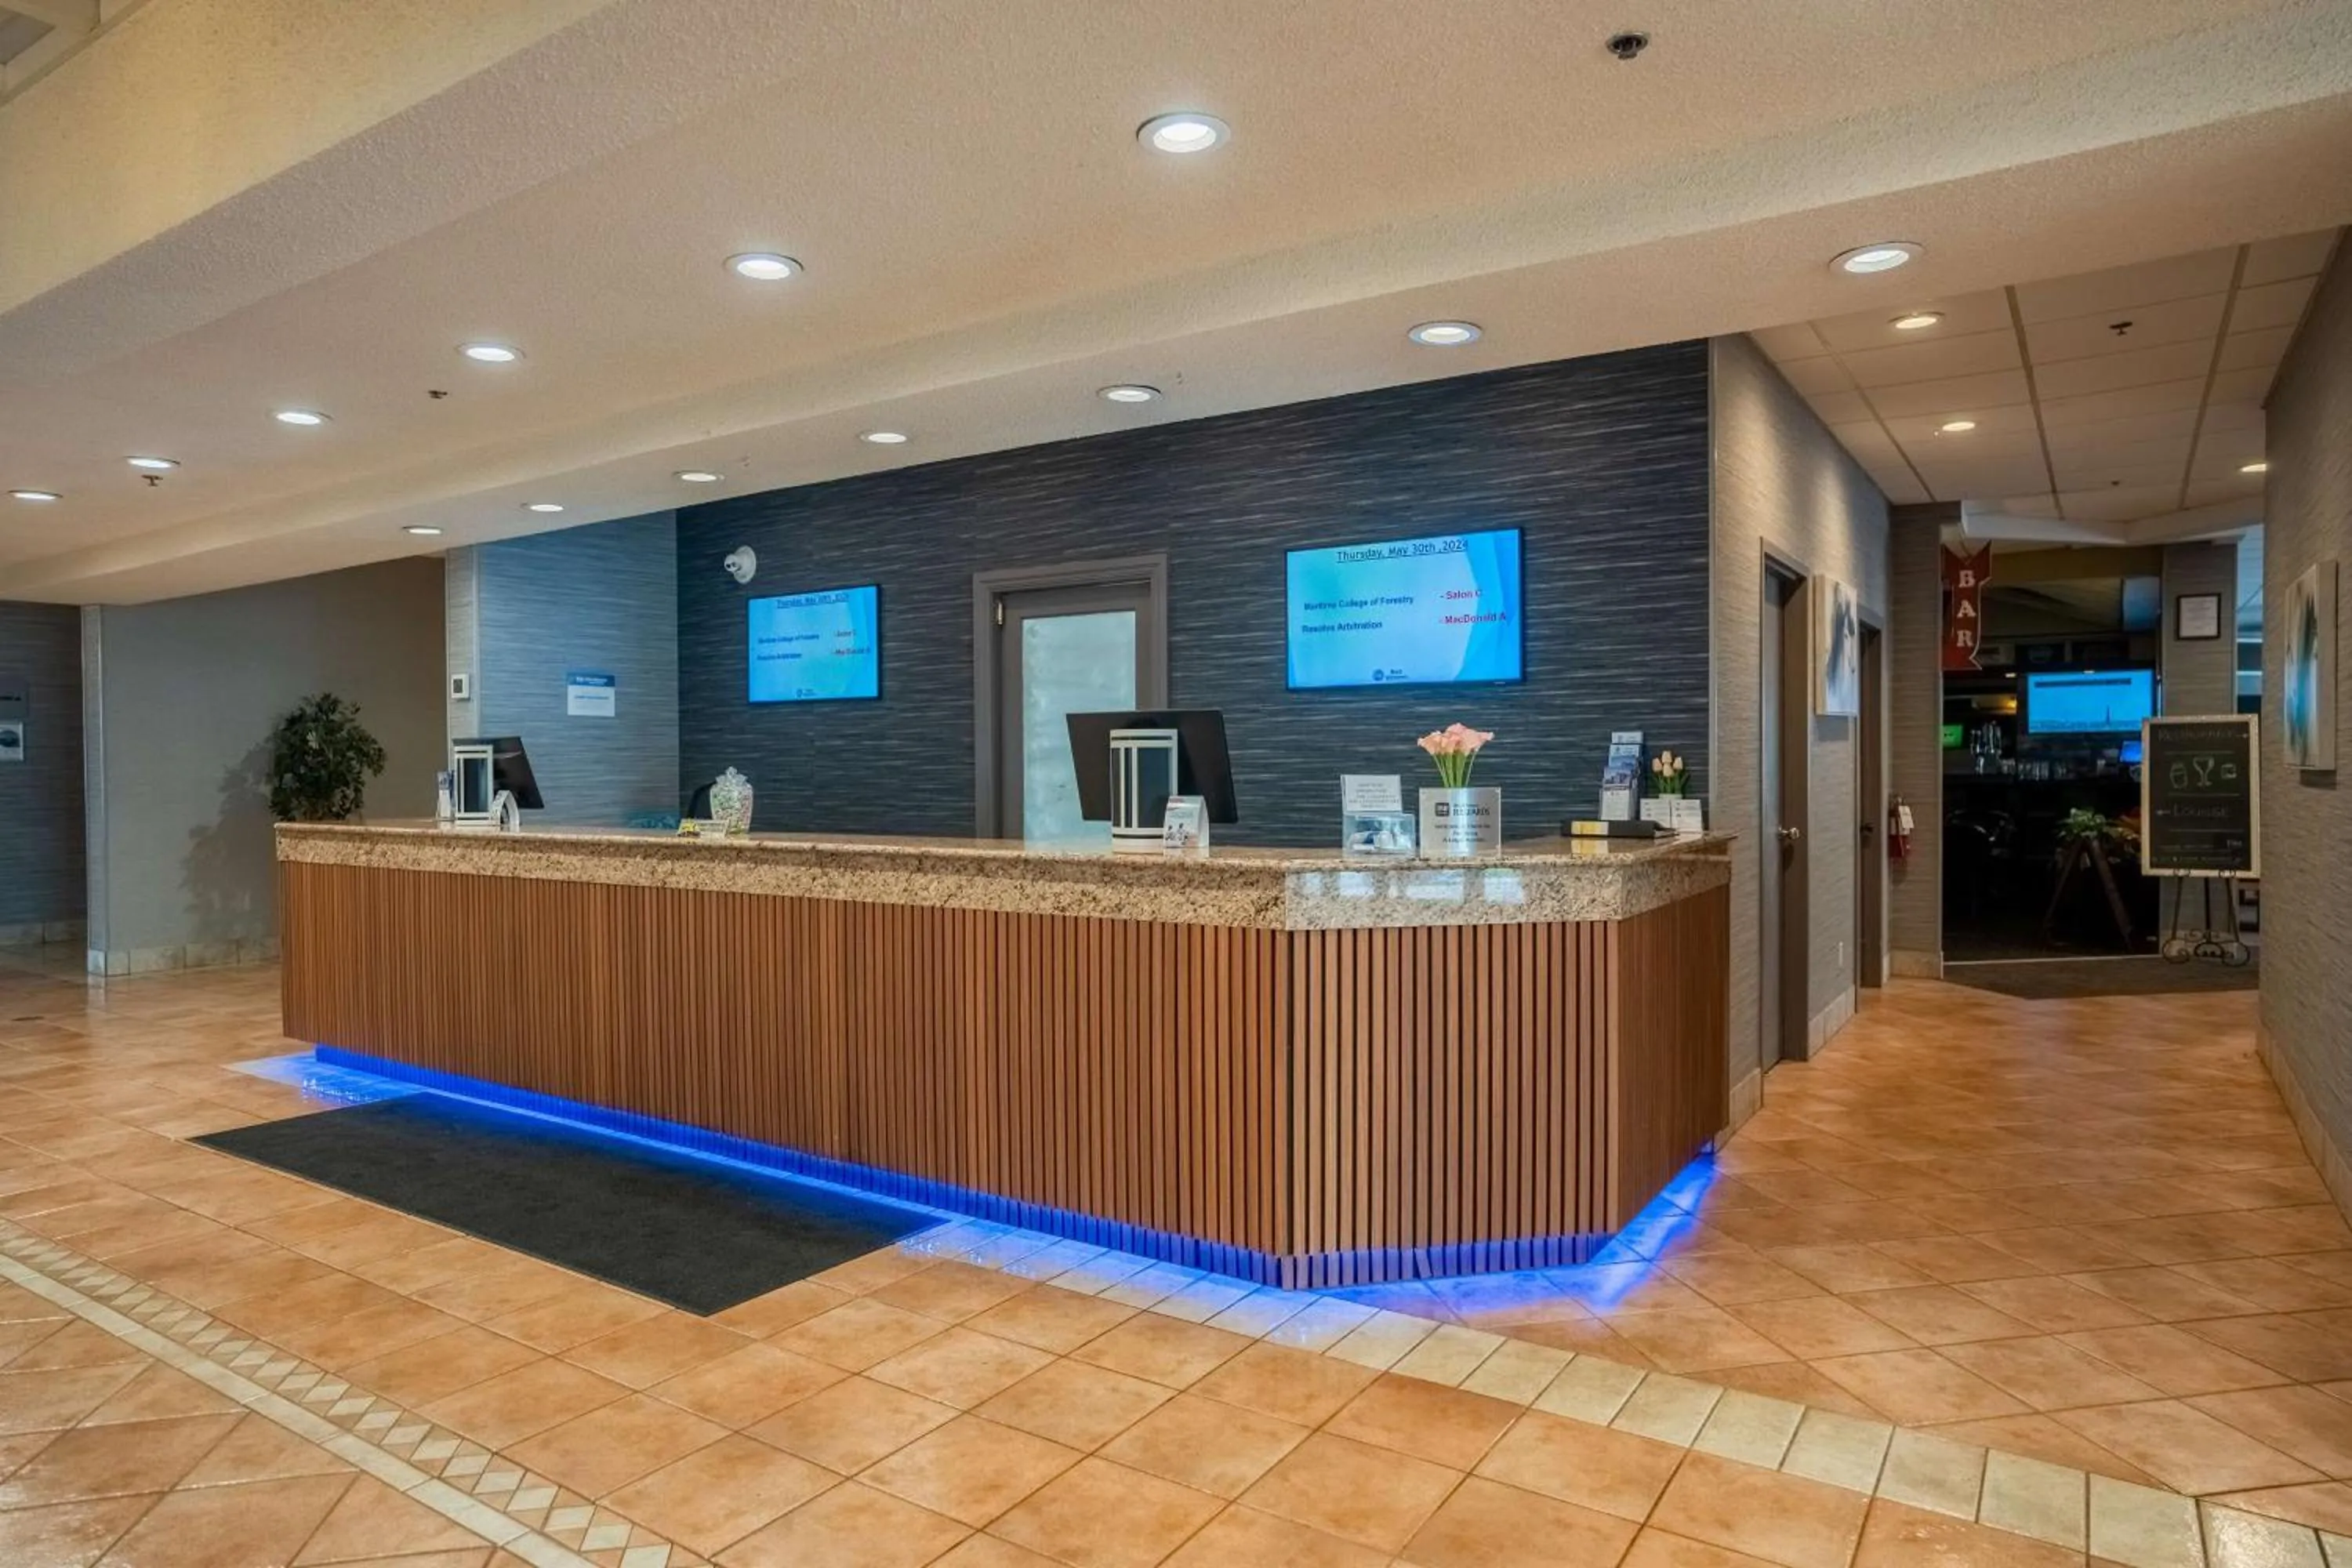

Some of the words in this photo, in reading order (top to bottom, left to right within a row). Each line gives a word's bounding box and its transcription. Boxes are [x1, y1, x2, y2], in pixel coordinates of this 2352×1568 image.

[1336, 548, 1386, 563] Thursday,
[1388, 546, 1409, 558] May
[1412, 542, 1436, 555] 30th
[1446, 589, 1473, 600] Salon
[1338, 598, 1368, 608] College
[1380, 596, 1414, 605] Forestry
[1956, 569, 1977, 648] BAR
[1445, 613, 1497, 624] MacDonald
